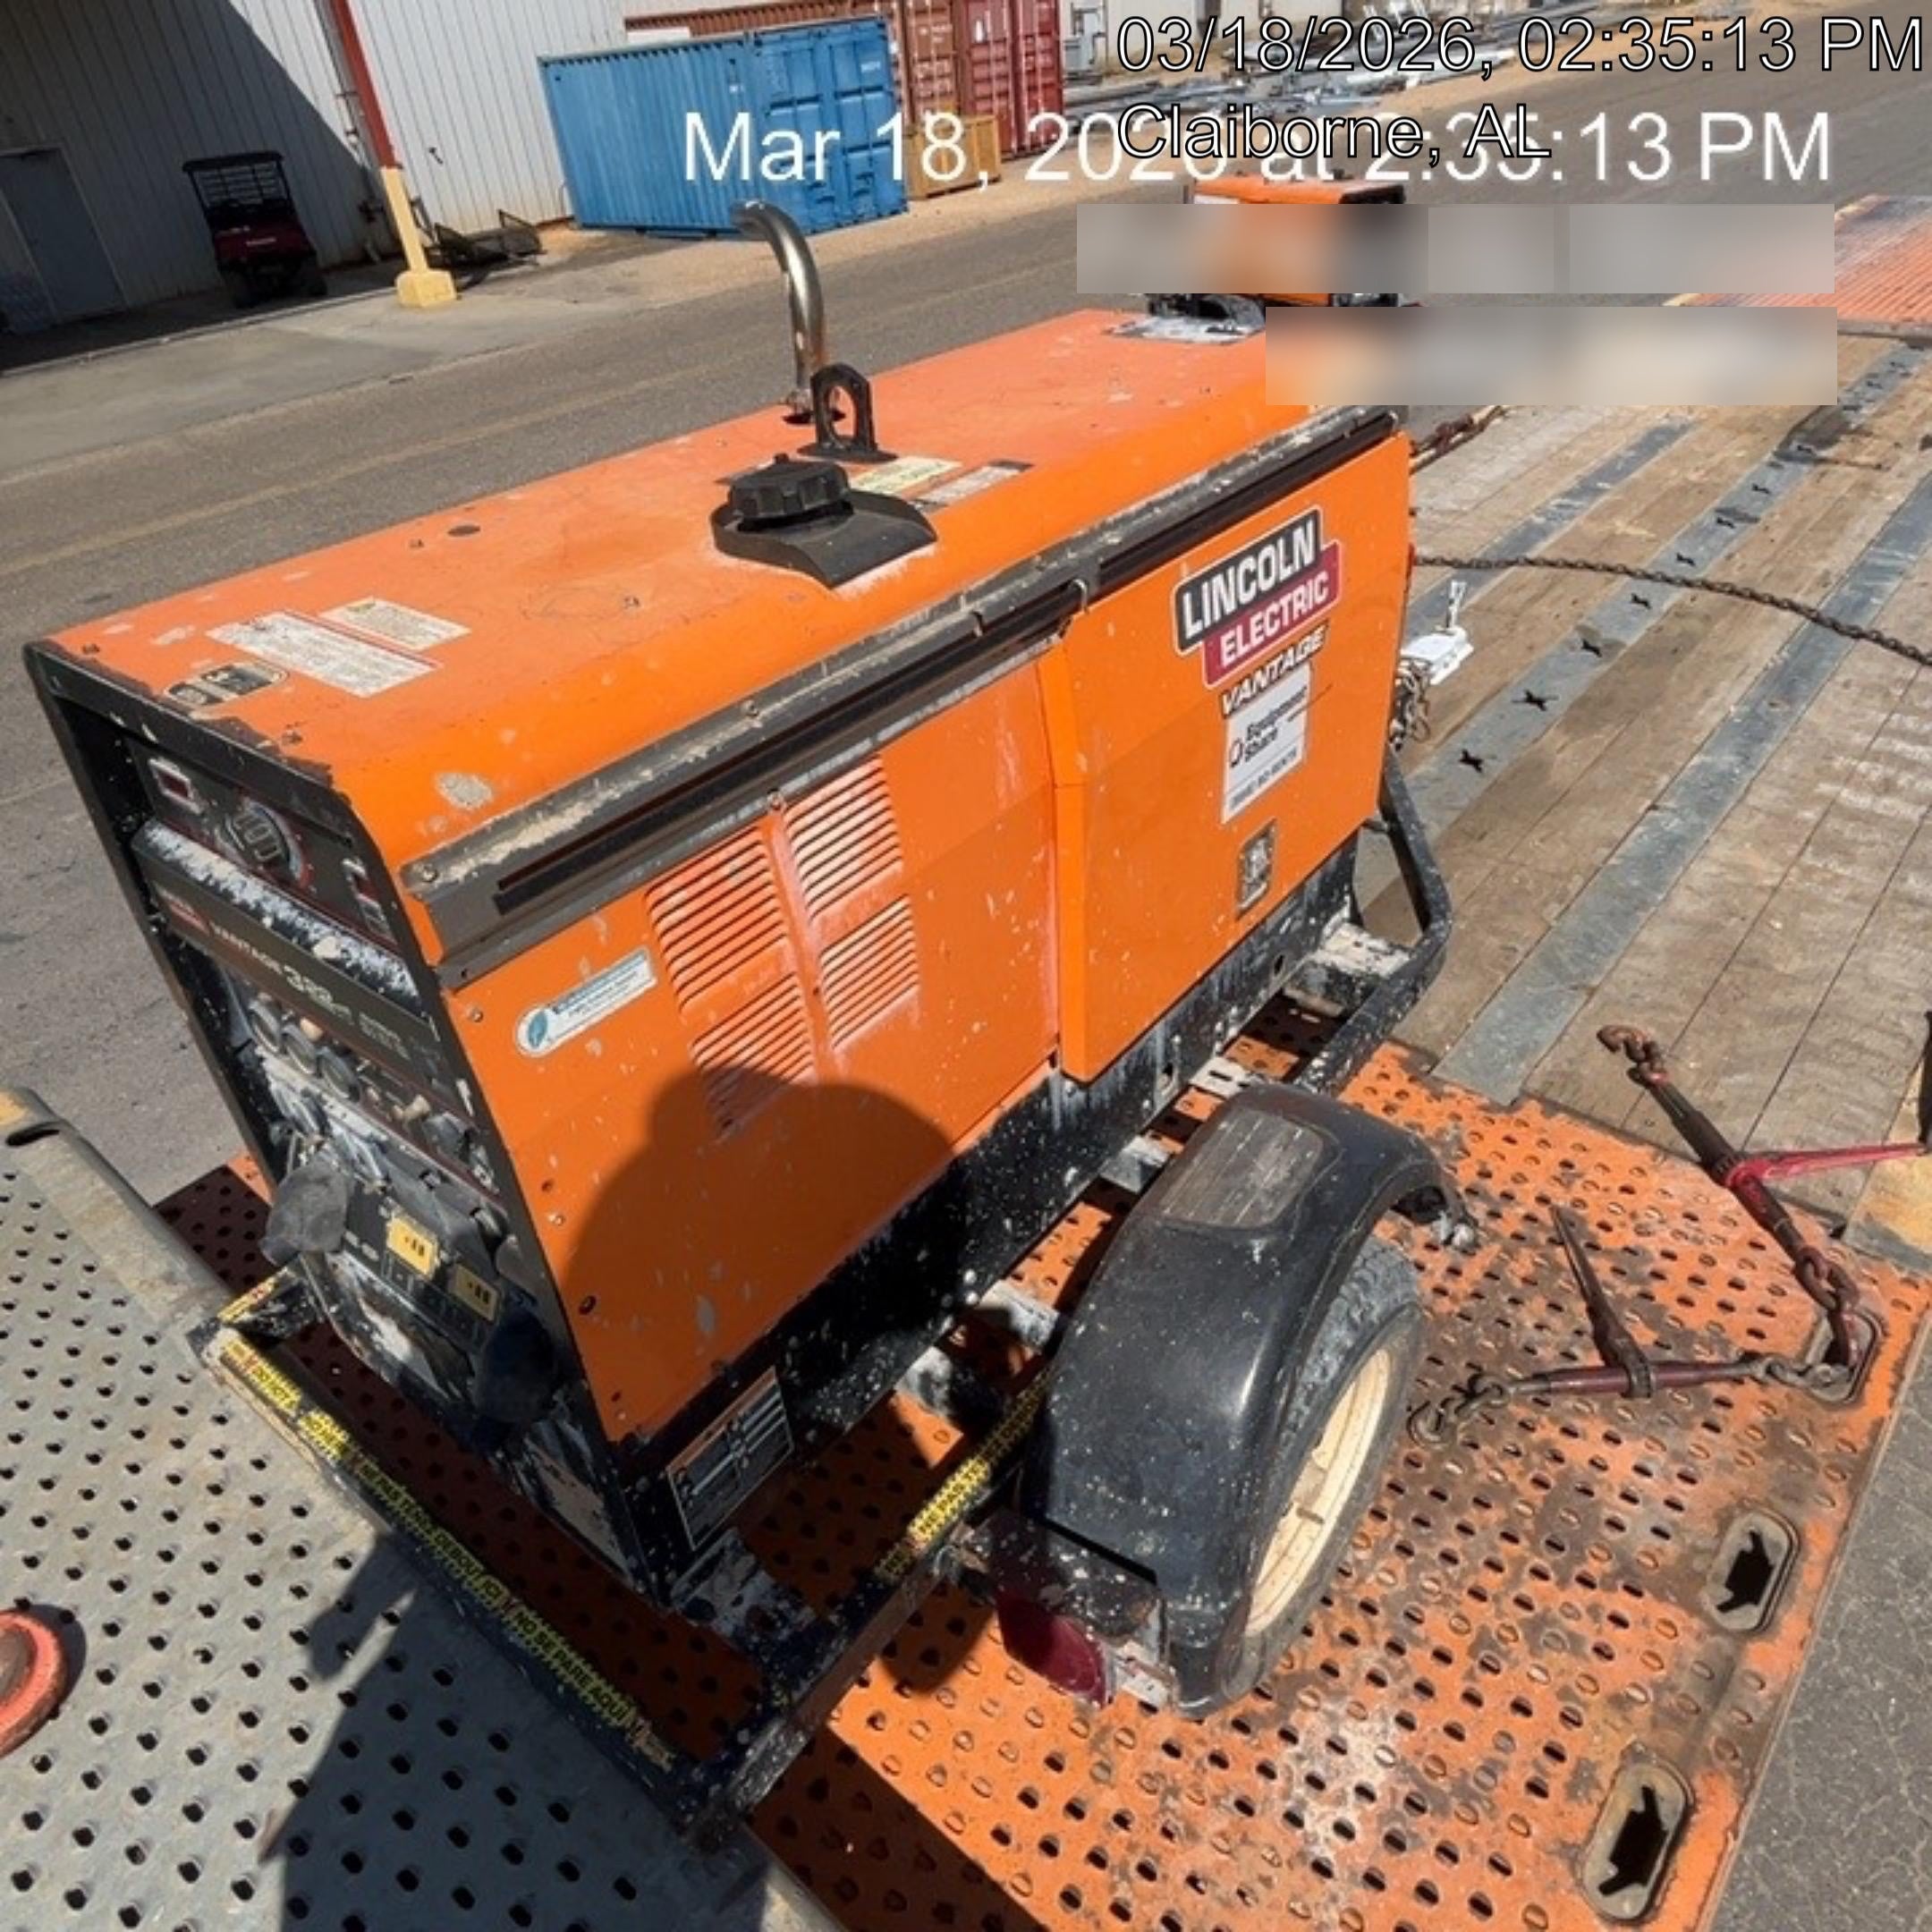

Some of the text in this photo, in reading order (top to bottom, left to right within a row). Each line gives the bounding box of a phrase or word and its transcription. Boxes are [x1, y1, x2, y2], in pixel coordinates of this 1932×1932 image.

[1182, 519, 1315, 640] LINCOLN
[1220, 571, 1329, 667] ELECTRIC
[1222, 621, 1327, 717] VANTAGE
[512, 1609, 538, 1635] NO
[533, 1630, 555, 1653] SE
[552, 1648, 594, 1690] PARE
